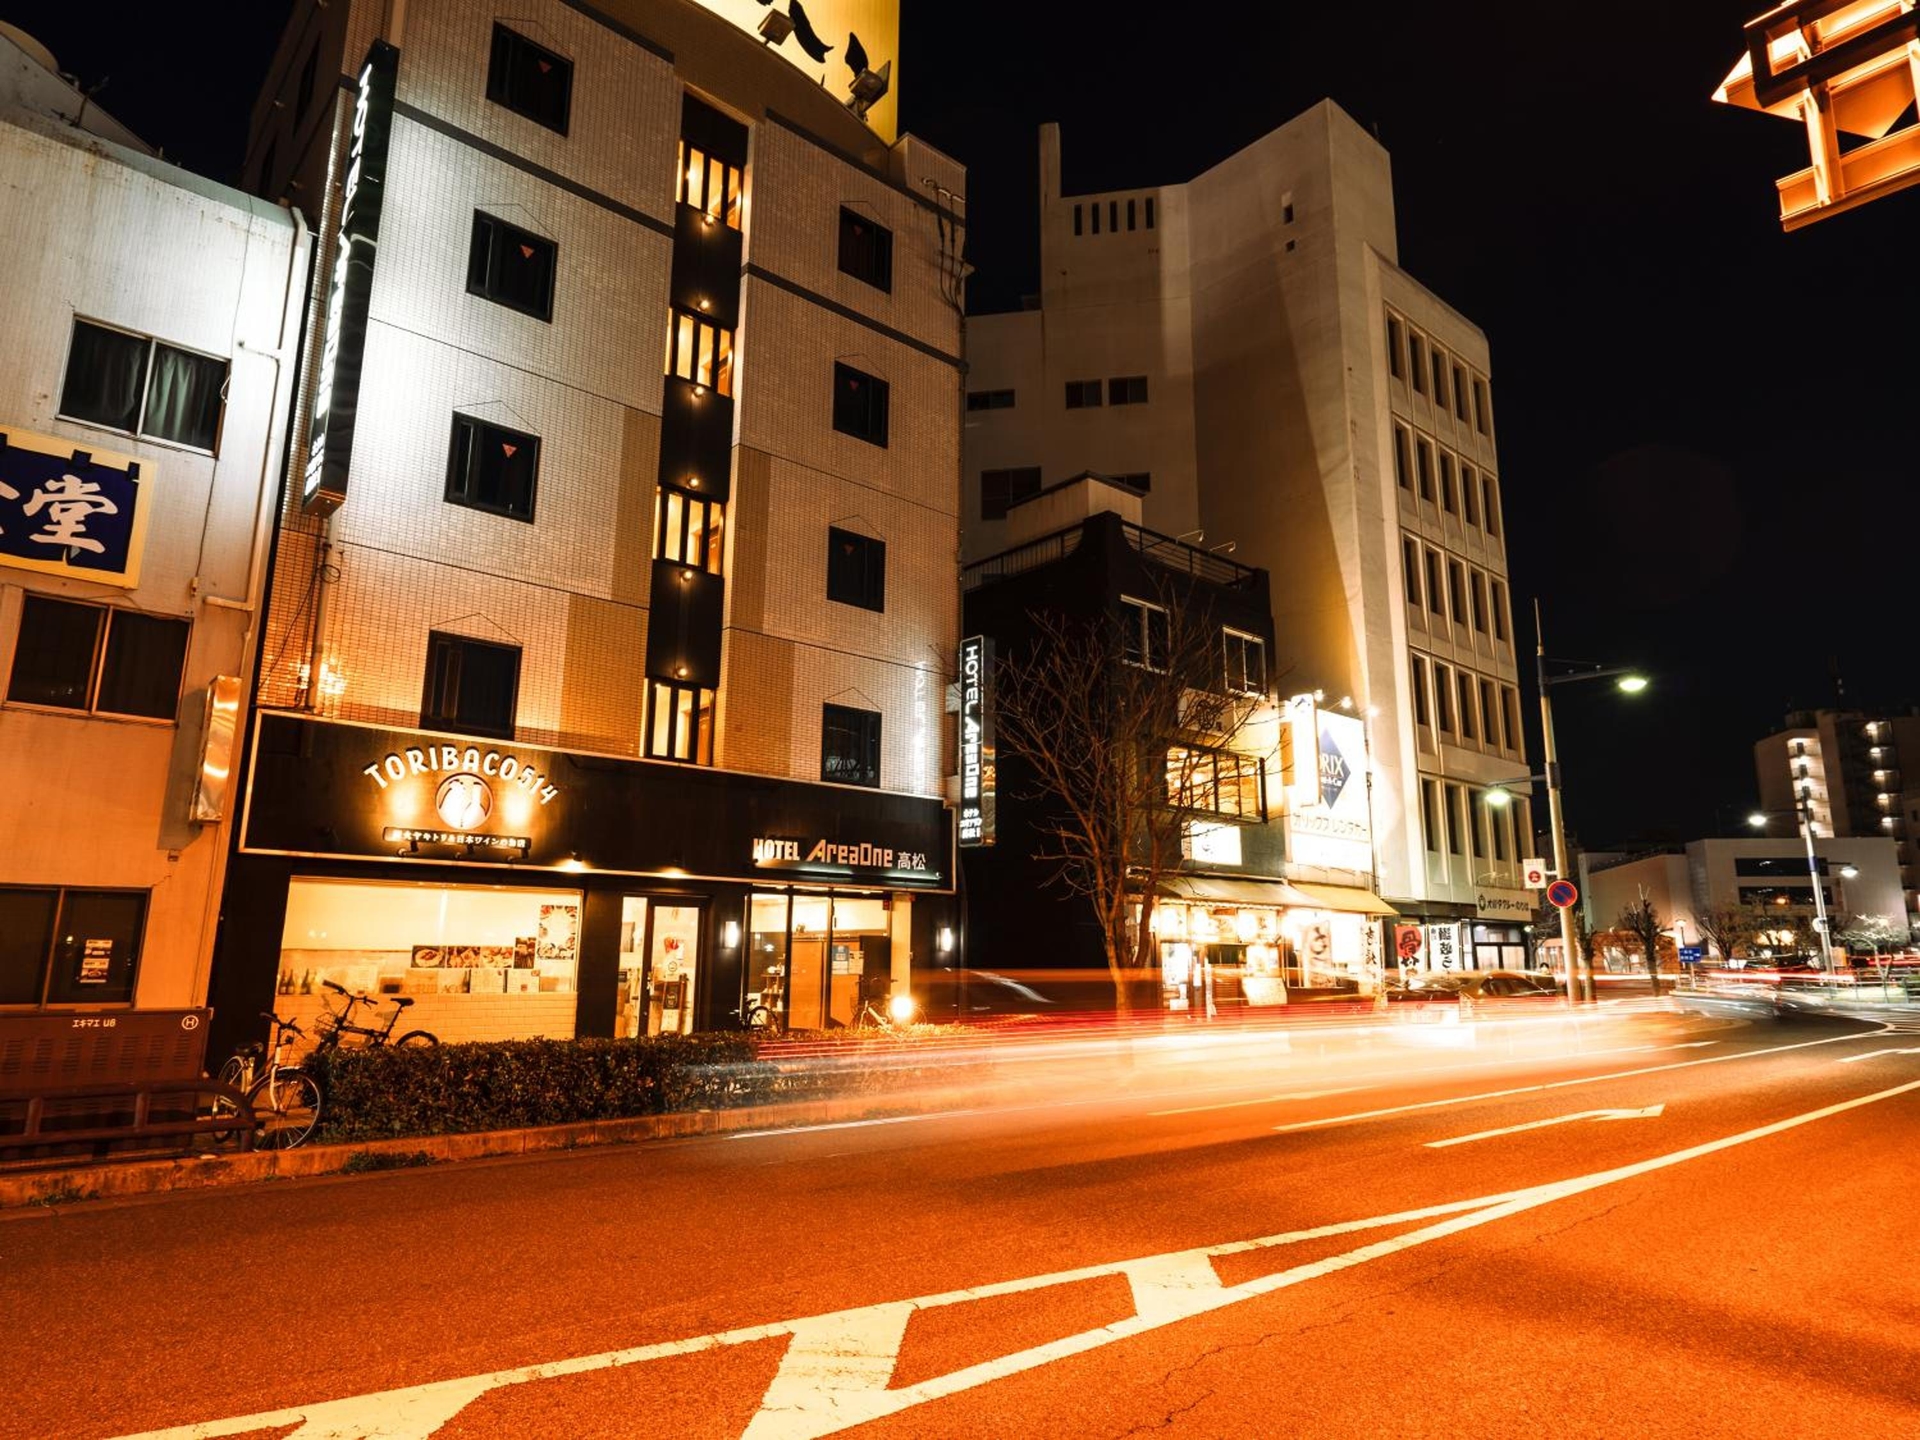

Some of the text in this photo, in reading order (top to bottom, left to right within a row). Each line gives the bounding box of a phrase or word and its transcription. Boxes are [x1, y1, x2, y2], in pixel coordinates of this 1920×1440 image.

[0, 474, 118, 554] 堂
[965, 645, 979, 715] HOTEL
[363, 745, 560, 805] TORIBACO514
[752, 838, 926, 871] HOTEL AreaOne 高松
